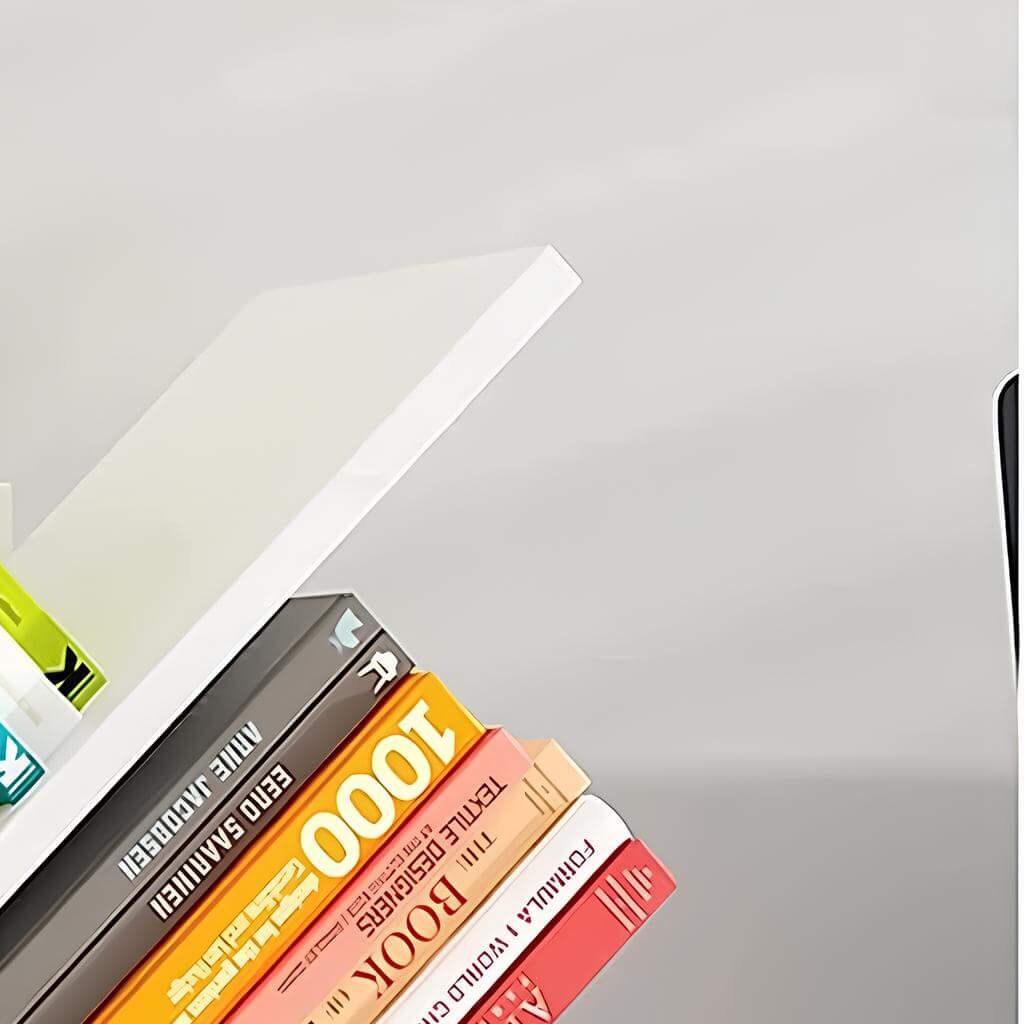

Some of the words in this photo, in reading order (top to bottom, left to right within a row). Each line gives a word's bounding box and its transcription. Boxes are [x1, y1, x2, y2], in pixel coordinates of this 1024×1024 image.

[300, 699, 454, 876] 1000
[356, 839, 445, 937] DESIGNERS
[517, 839, 593, 922] FORMULA
[351, 875, 466, 998] BOOK
[447, 937, 507, 1001] WORLD
